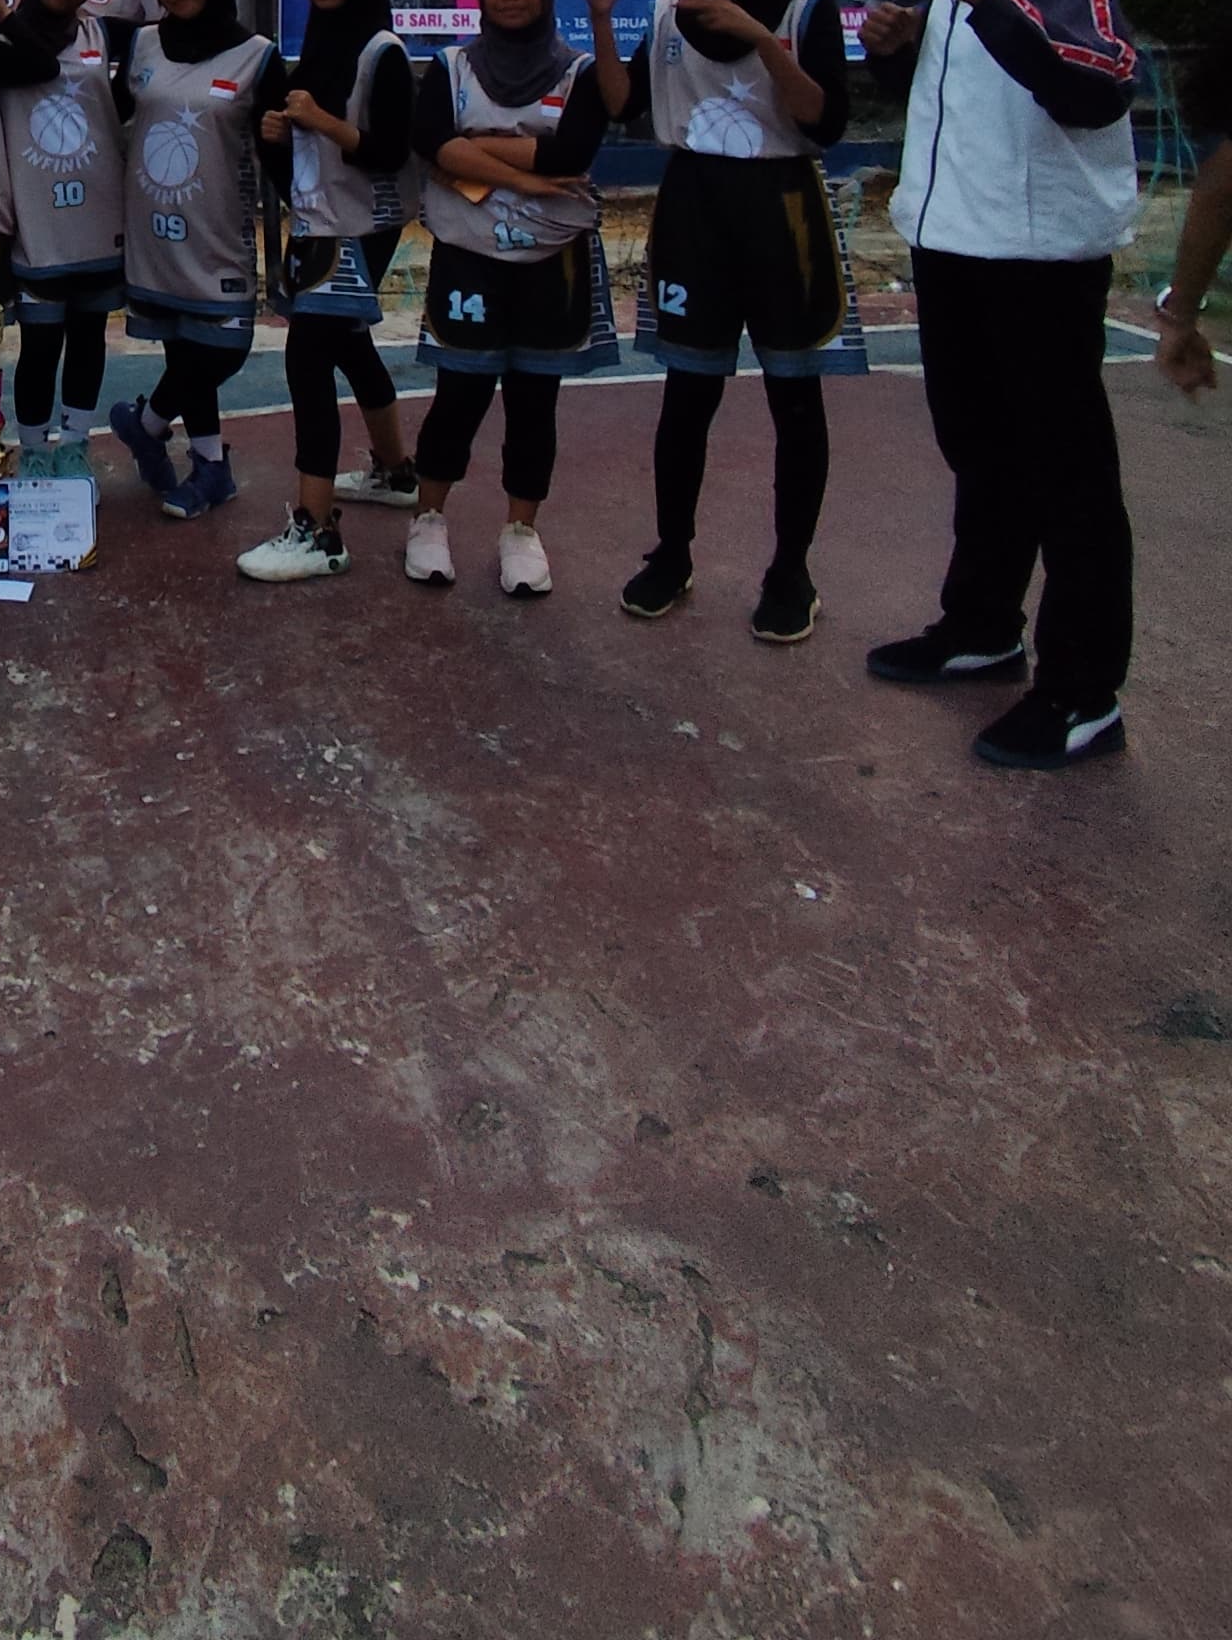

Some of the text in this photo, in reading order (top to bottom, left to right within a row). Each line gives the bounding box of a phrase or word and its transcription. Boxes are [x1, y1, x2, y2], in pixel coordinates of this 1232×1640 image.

[52, 179, 85, 208] 10
[151, 211, 188, 241] 09
[447, 288, 486, 323] 14
